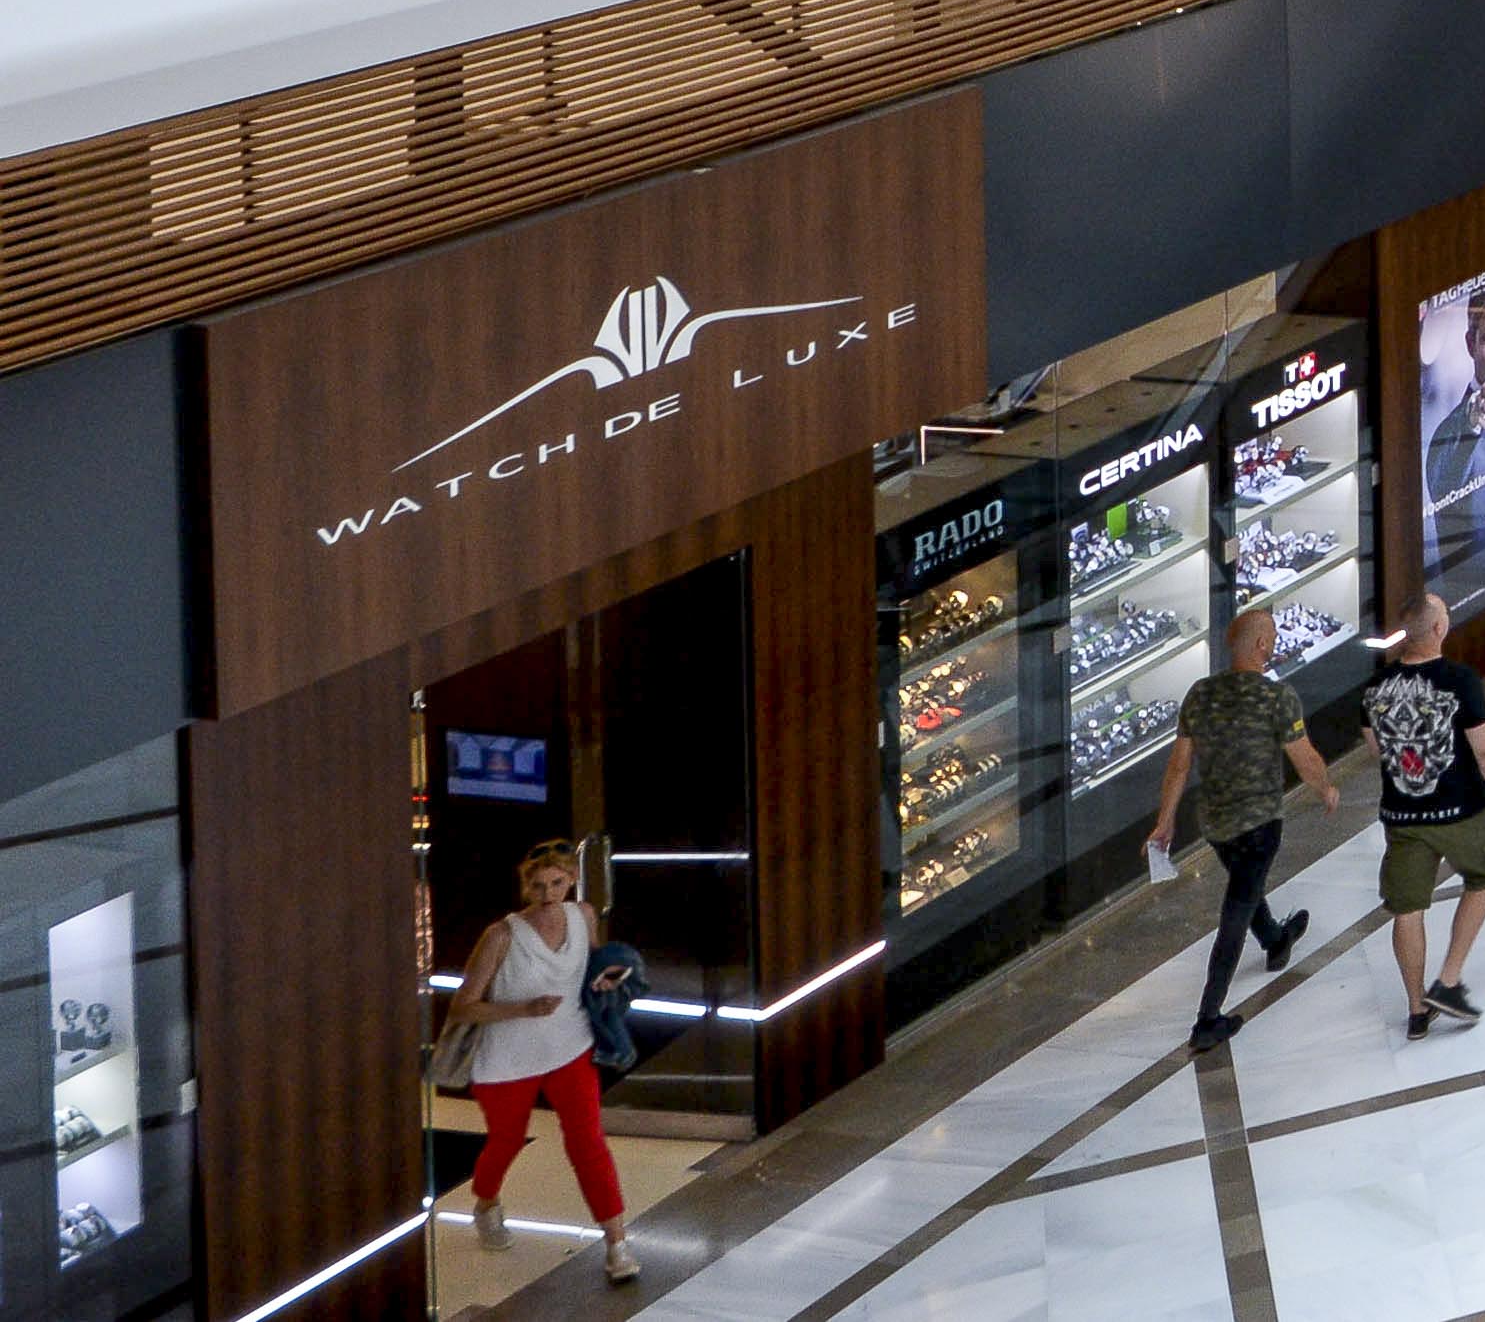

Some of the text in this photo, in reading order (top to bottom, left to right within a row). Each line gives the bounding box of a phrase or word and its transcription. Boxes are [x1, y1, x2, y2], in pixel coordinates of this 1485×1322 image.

[316, 303, 916, 545] WATCH DE LUXE
[1251, 363, 1345, 428] TISSOT
[1079, 423, 1203, 496] CERTINA
[913, 498, 1003, 560] RADO
